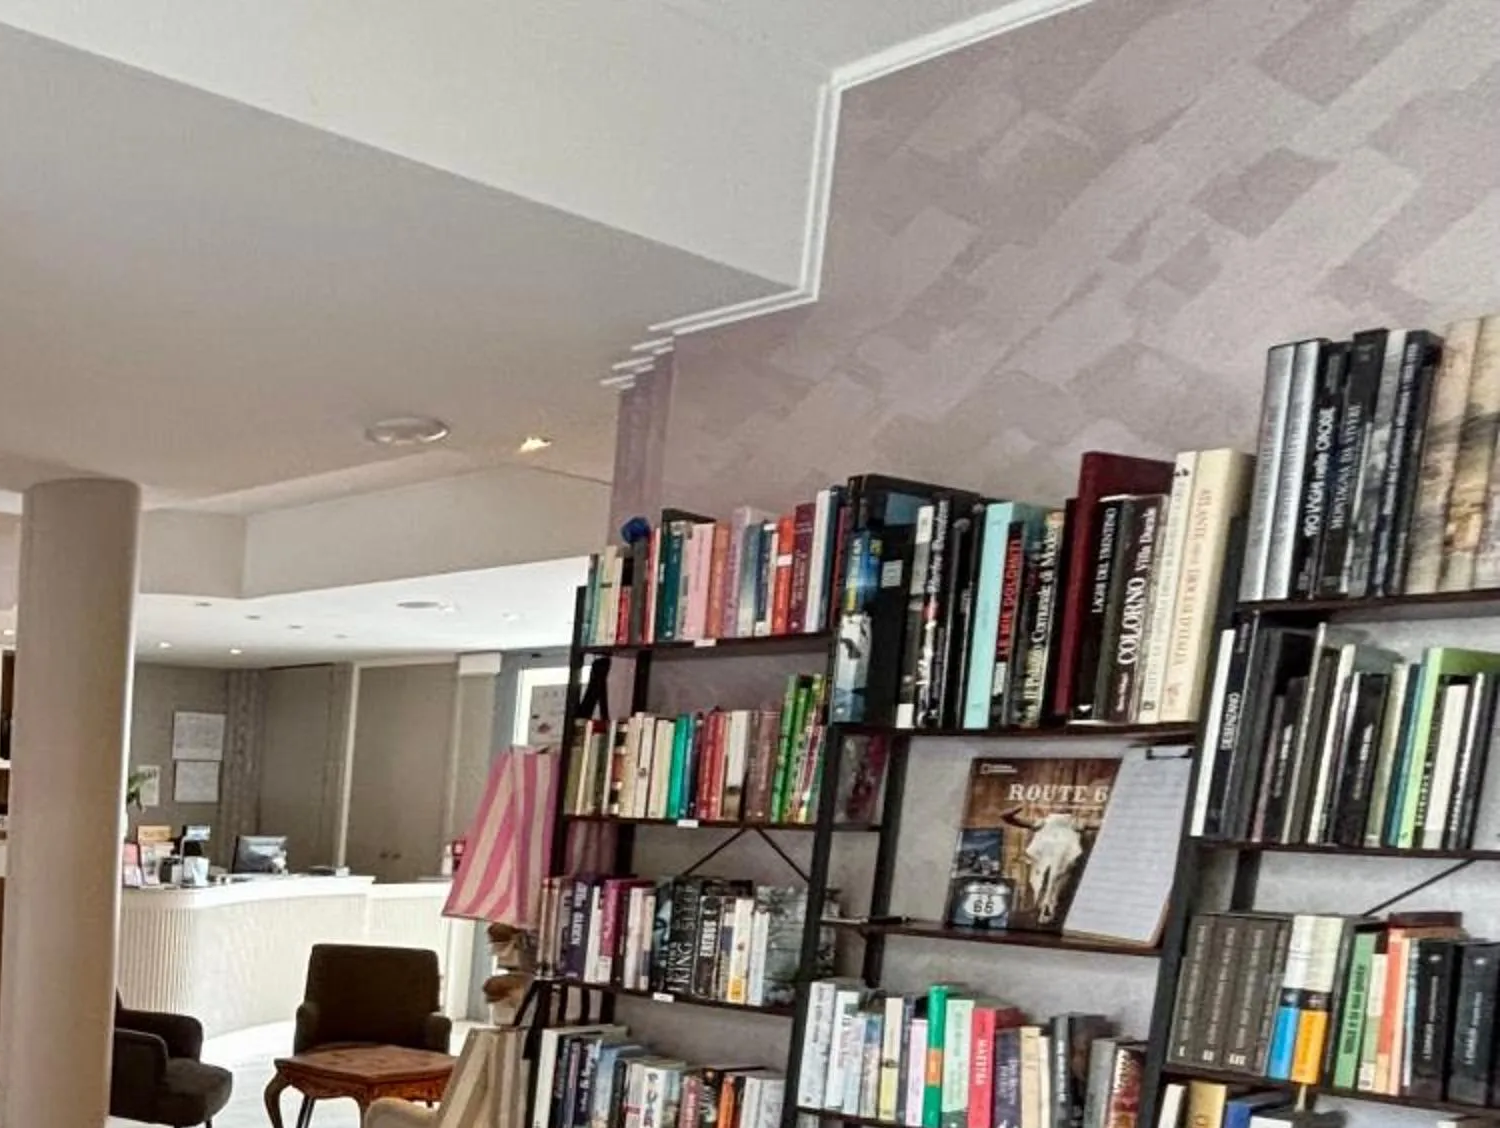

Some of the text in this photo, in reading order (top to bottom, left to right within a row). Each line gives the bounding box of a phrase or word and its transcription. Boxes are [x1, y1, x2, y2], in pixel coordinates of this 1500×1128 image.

[1117, 576, 1146, 665] COLORNO
[1008, 783, 1109, 801] ROUTE 6
